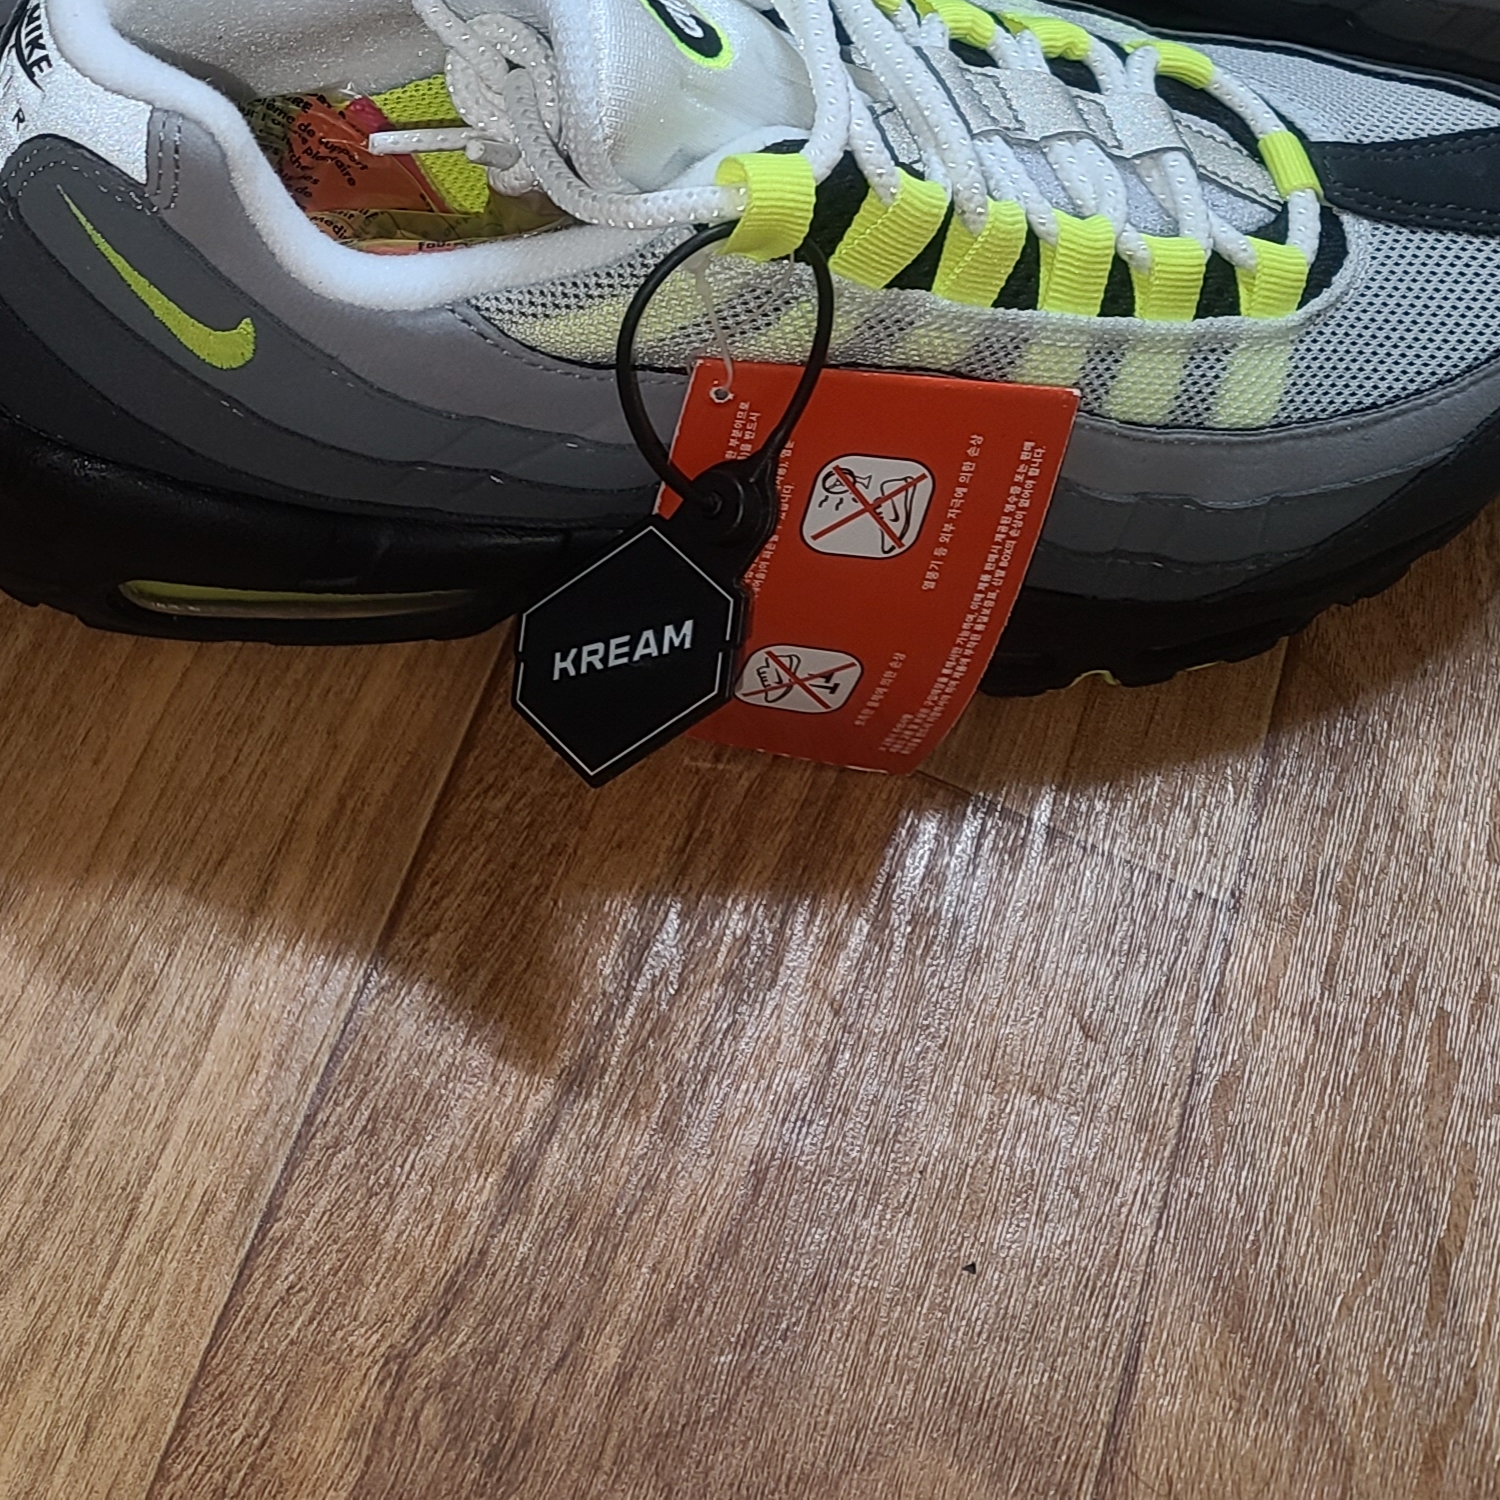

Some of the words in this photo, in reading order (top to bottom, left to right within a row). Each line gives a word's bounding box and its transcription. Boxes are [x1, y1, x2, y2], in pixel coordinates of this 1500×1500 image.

[967, 435, 983, 456] 손상
[959, 462, 976, 483] 의한
[1014, 464, 1028, 482] 또는
[947, 487, 968, 518] 자극에
[939, 523, 955, 543] 외부
[999, 540, 1017, 567] BOX의
[1009, 511, 1027, 536] 손상이
[1018, 480, 1036, 507] 없어야
[934, 547, 947, 556] 등
[922, 561, 943, 589] 열풍기
[553, 619, 694, 681] KREAM
